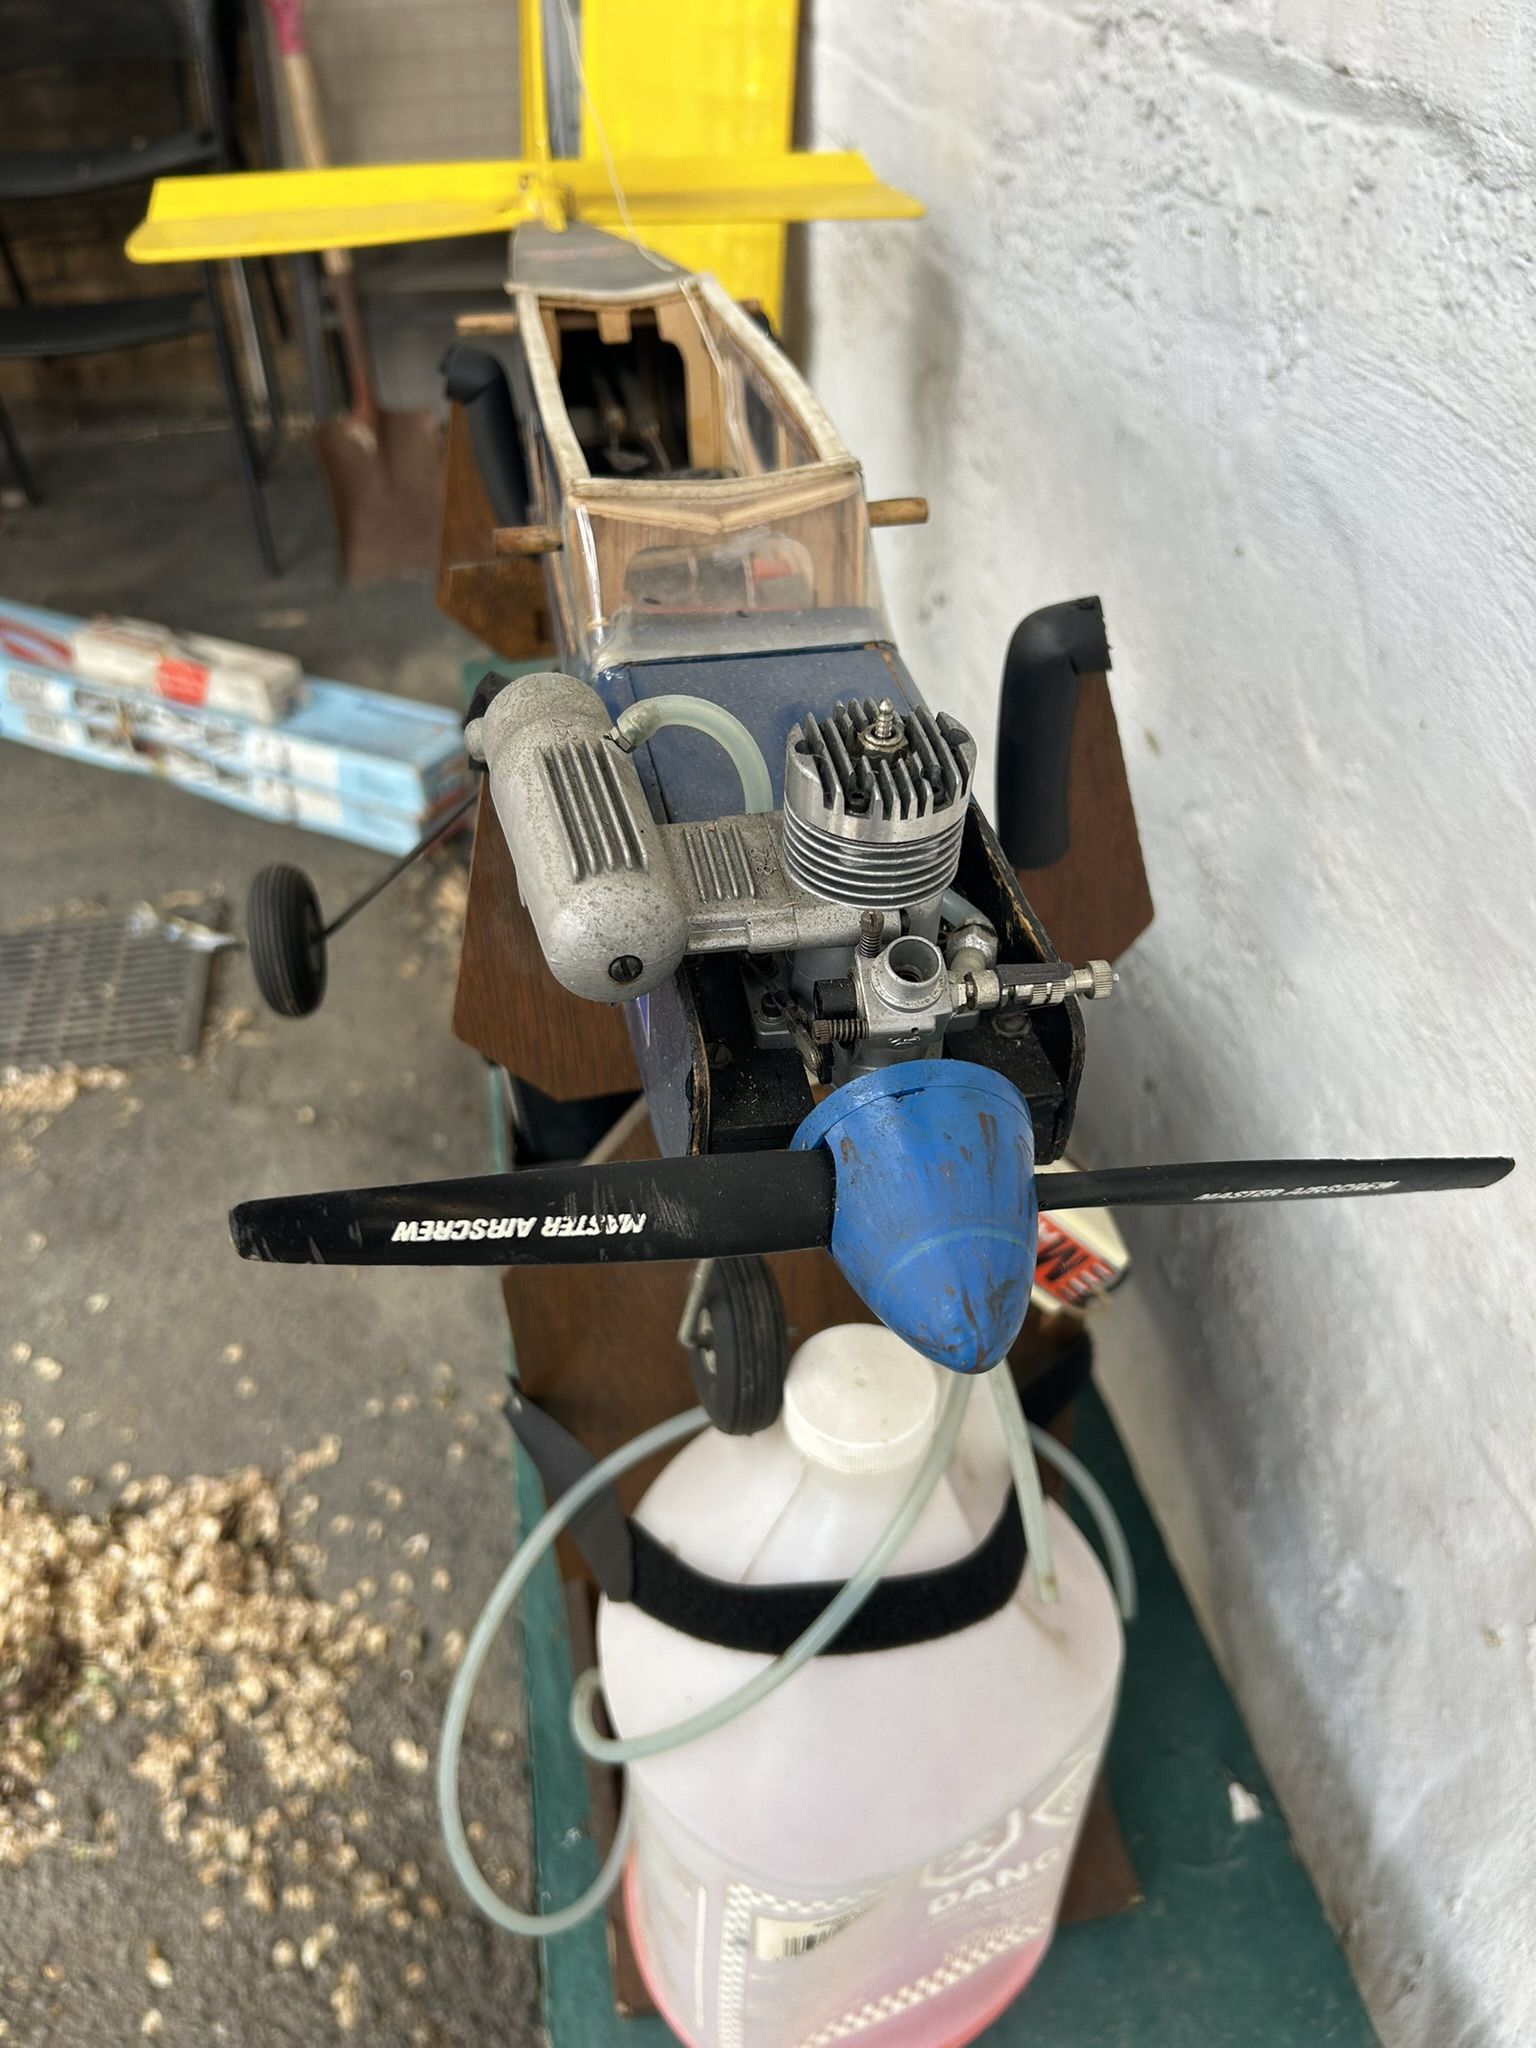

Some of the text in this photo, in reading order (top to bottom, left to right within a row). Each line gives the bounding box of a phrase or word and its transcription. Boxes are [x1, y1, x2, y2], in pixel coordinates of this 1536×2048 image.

[1193, 1180, 1401, 1201] MASTER AIRSCREW
[391, 1213, 647, 1242] MASTER AIRSCREW
